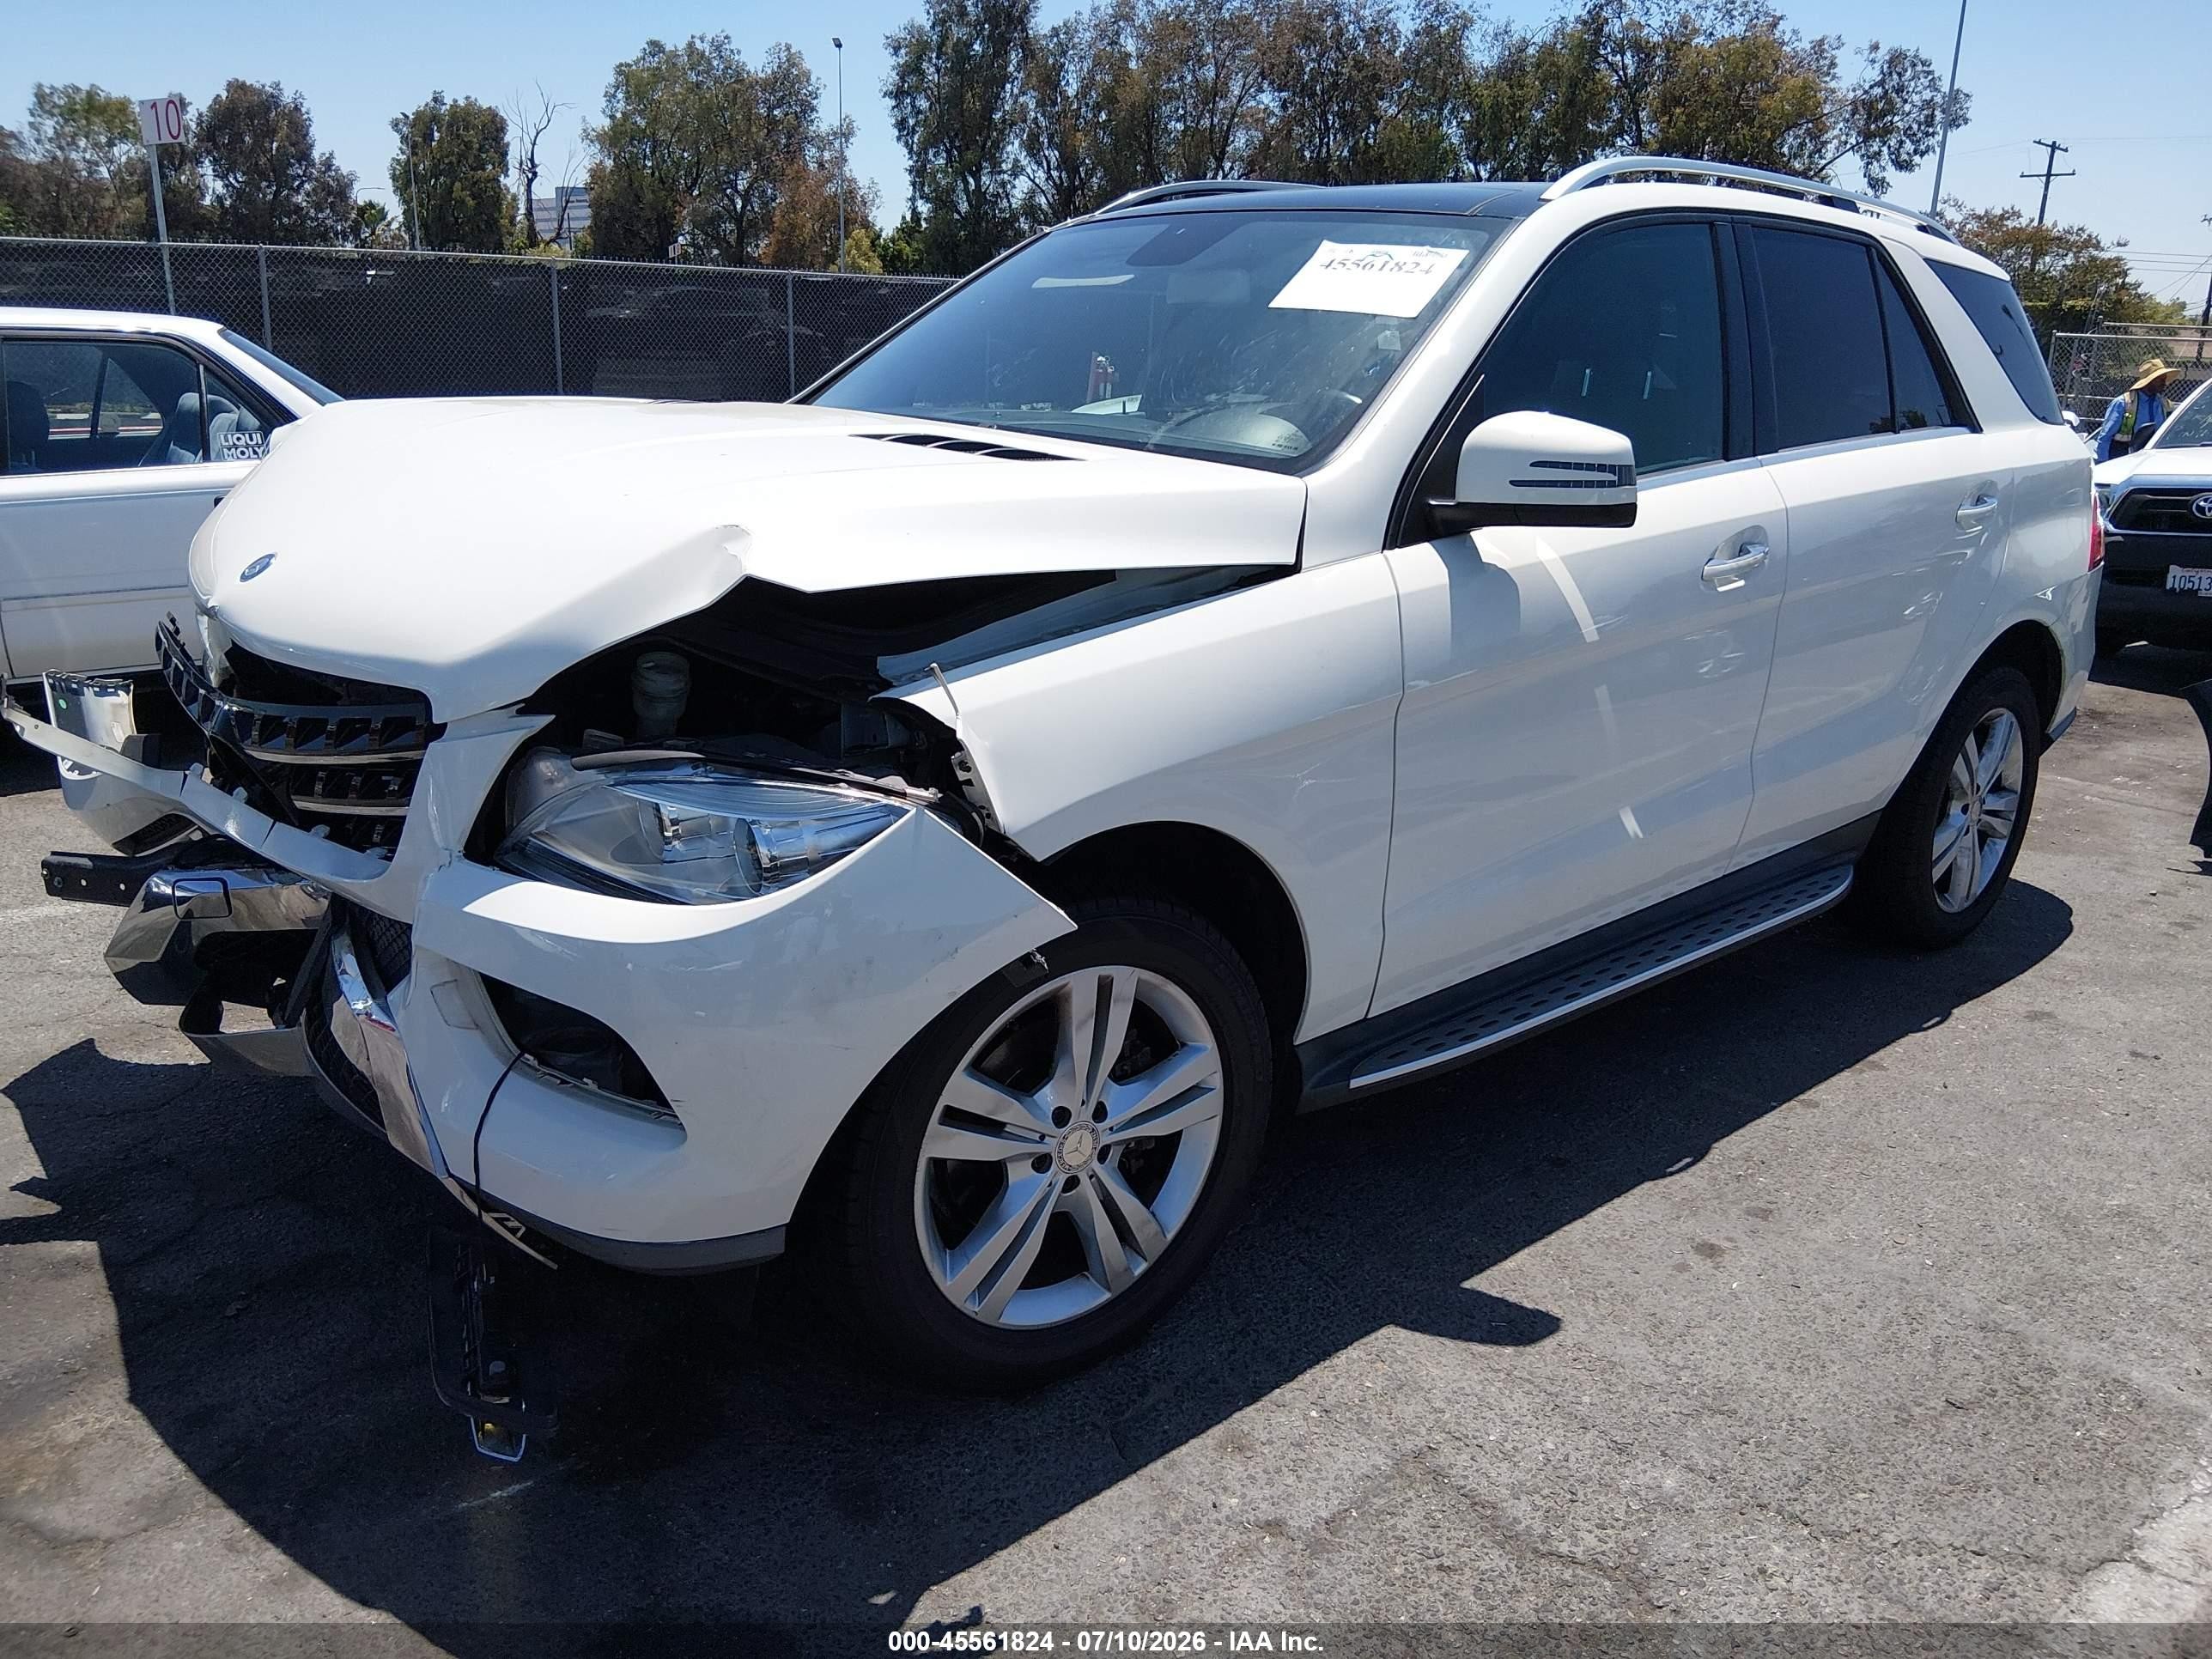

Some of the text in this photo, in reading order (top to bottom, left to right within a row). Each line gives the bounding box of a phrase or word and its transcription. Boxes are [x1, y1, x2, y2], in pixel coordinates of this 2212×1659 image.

[151, 100, 181, 141] 10
[1319, 258, 1436, 275] 45561824
[219, 433, 263, 446] LIQUI
[222, 447, 264, 459] MOLY
